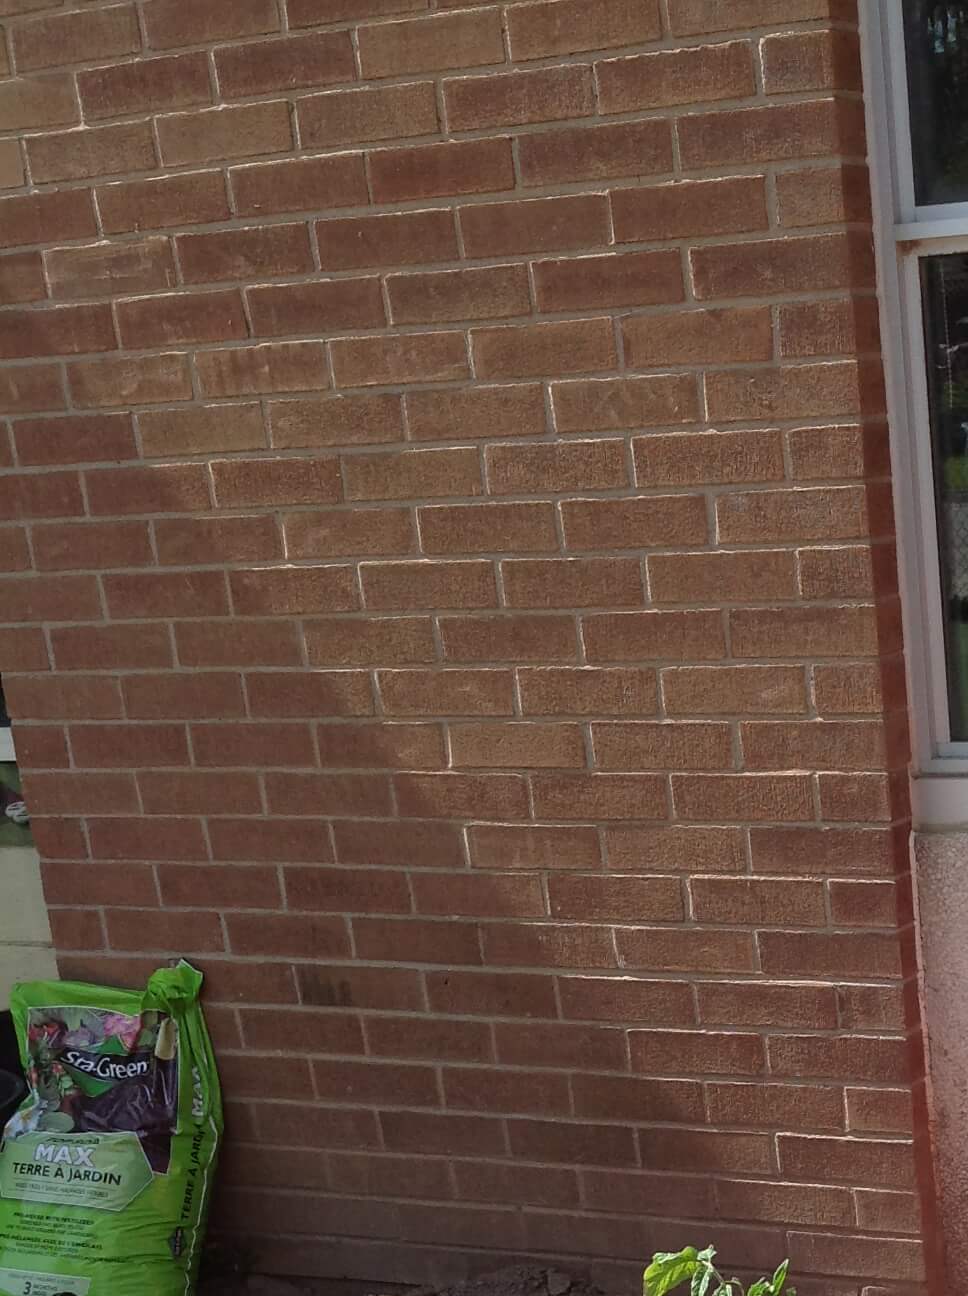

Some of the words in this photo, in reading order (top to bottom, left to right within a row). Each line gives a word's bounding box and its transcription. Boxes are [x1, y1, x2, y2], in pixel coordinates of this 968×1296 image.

[60, 1051, 148, 1078] Sta-Green
[34, 1143, 97, 1168] MAX
[12, 1161, 50, 1177] TERRE
[67, 1169, 122, 1186] JARDIN
[23, 1280, 32, 1296] 3
